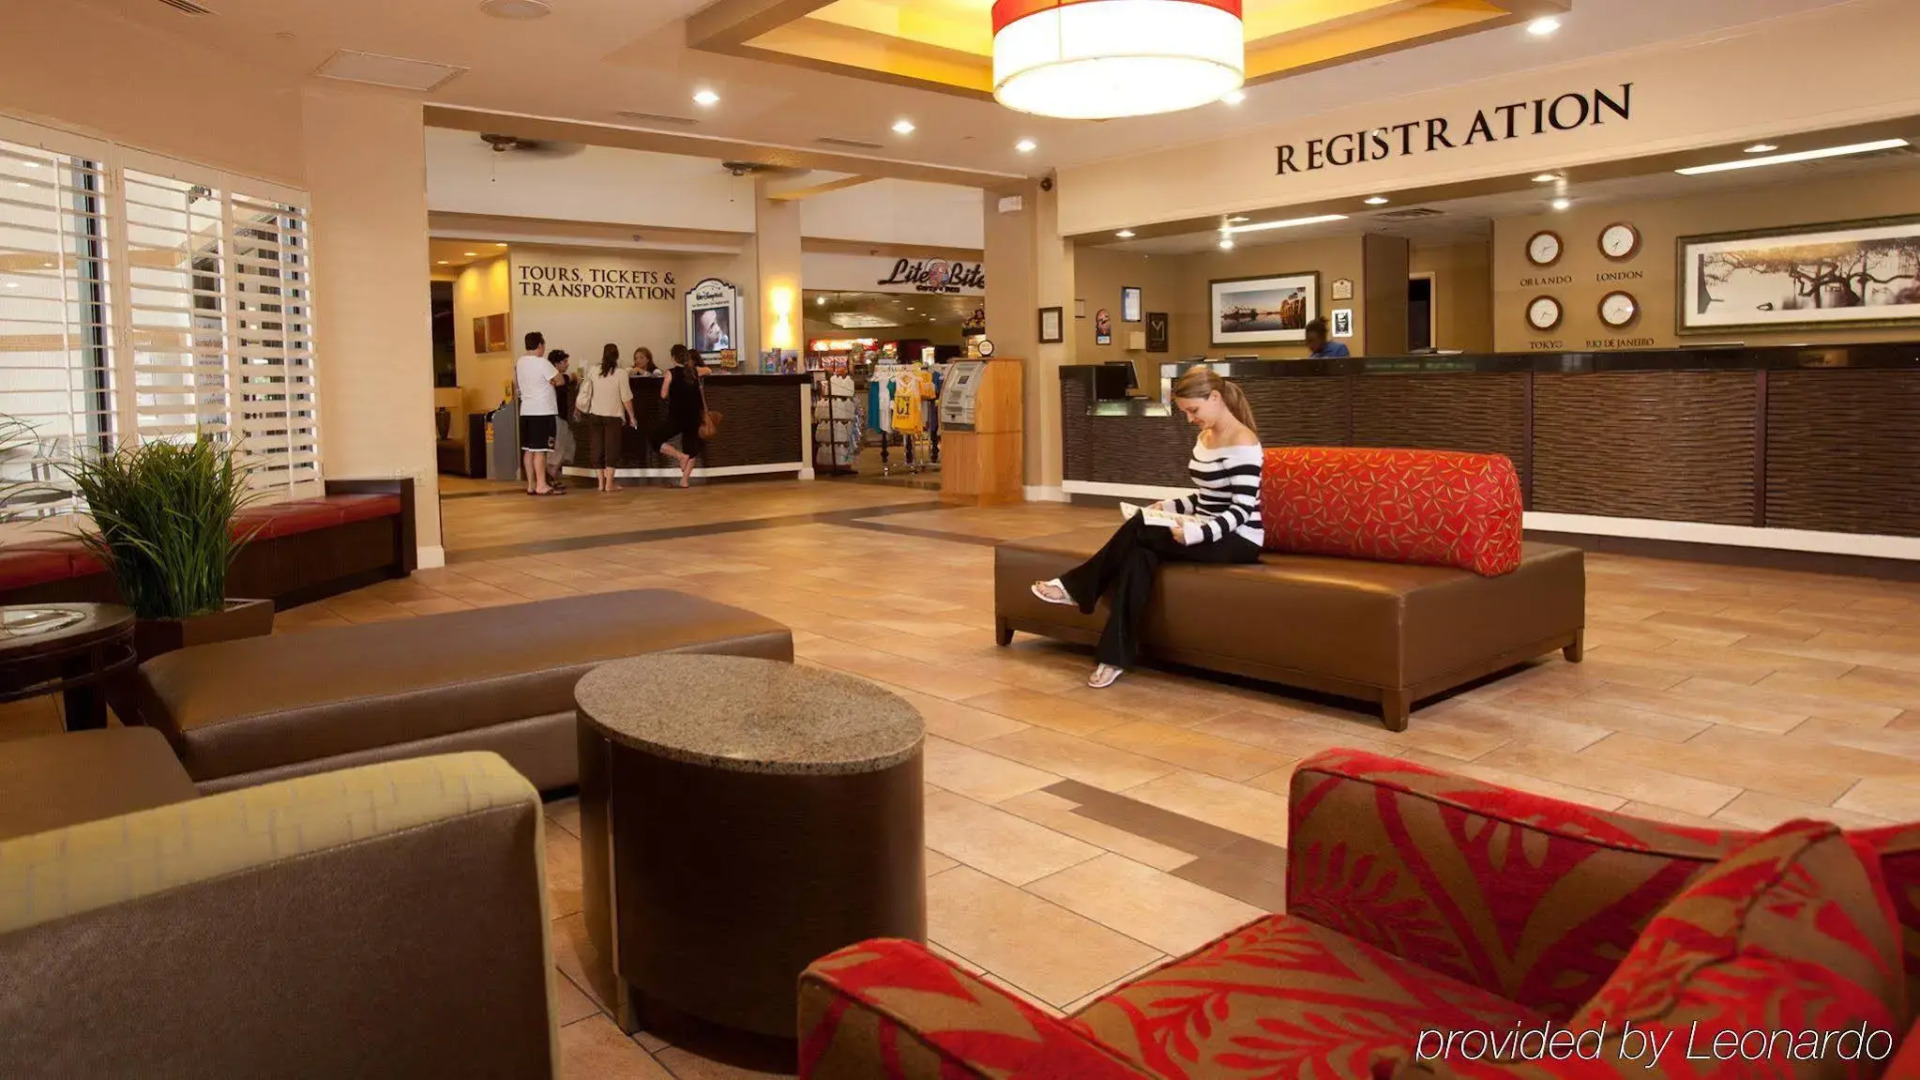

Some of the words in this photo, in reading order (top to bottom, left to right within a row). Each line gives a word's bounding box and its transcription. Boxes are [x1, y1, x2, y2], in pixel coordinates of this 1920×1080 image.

[1275, 82, 1634, 175] REGISTRATION
[518, 266, 584, 282] TOURS,
[589, 269, 658, 284] TICKETS
[663, 271, 676, 285] &
[877, 259, 930, 285] Lite
[1596, 271, 1643, 281] LONDON
[1520, 275, 1572, 287] ORLANDO
[518, 282, 676, 300] TRANSPORTATION
[1530, 340, 1563, 349] TOKYO
[1586, 339, 1602, 348] RIO
[1604, 339, 1615, 348] DE
[1616, 338, 1655, 349] JANEIRO
